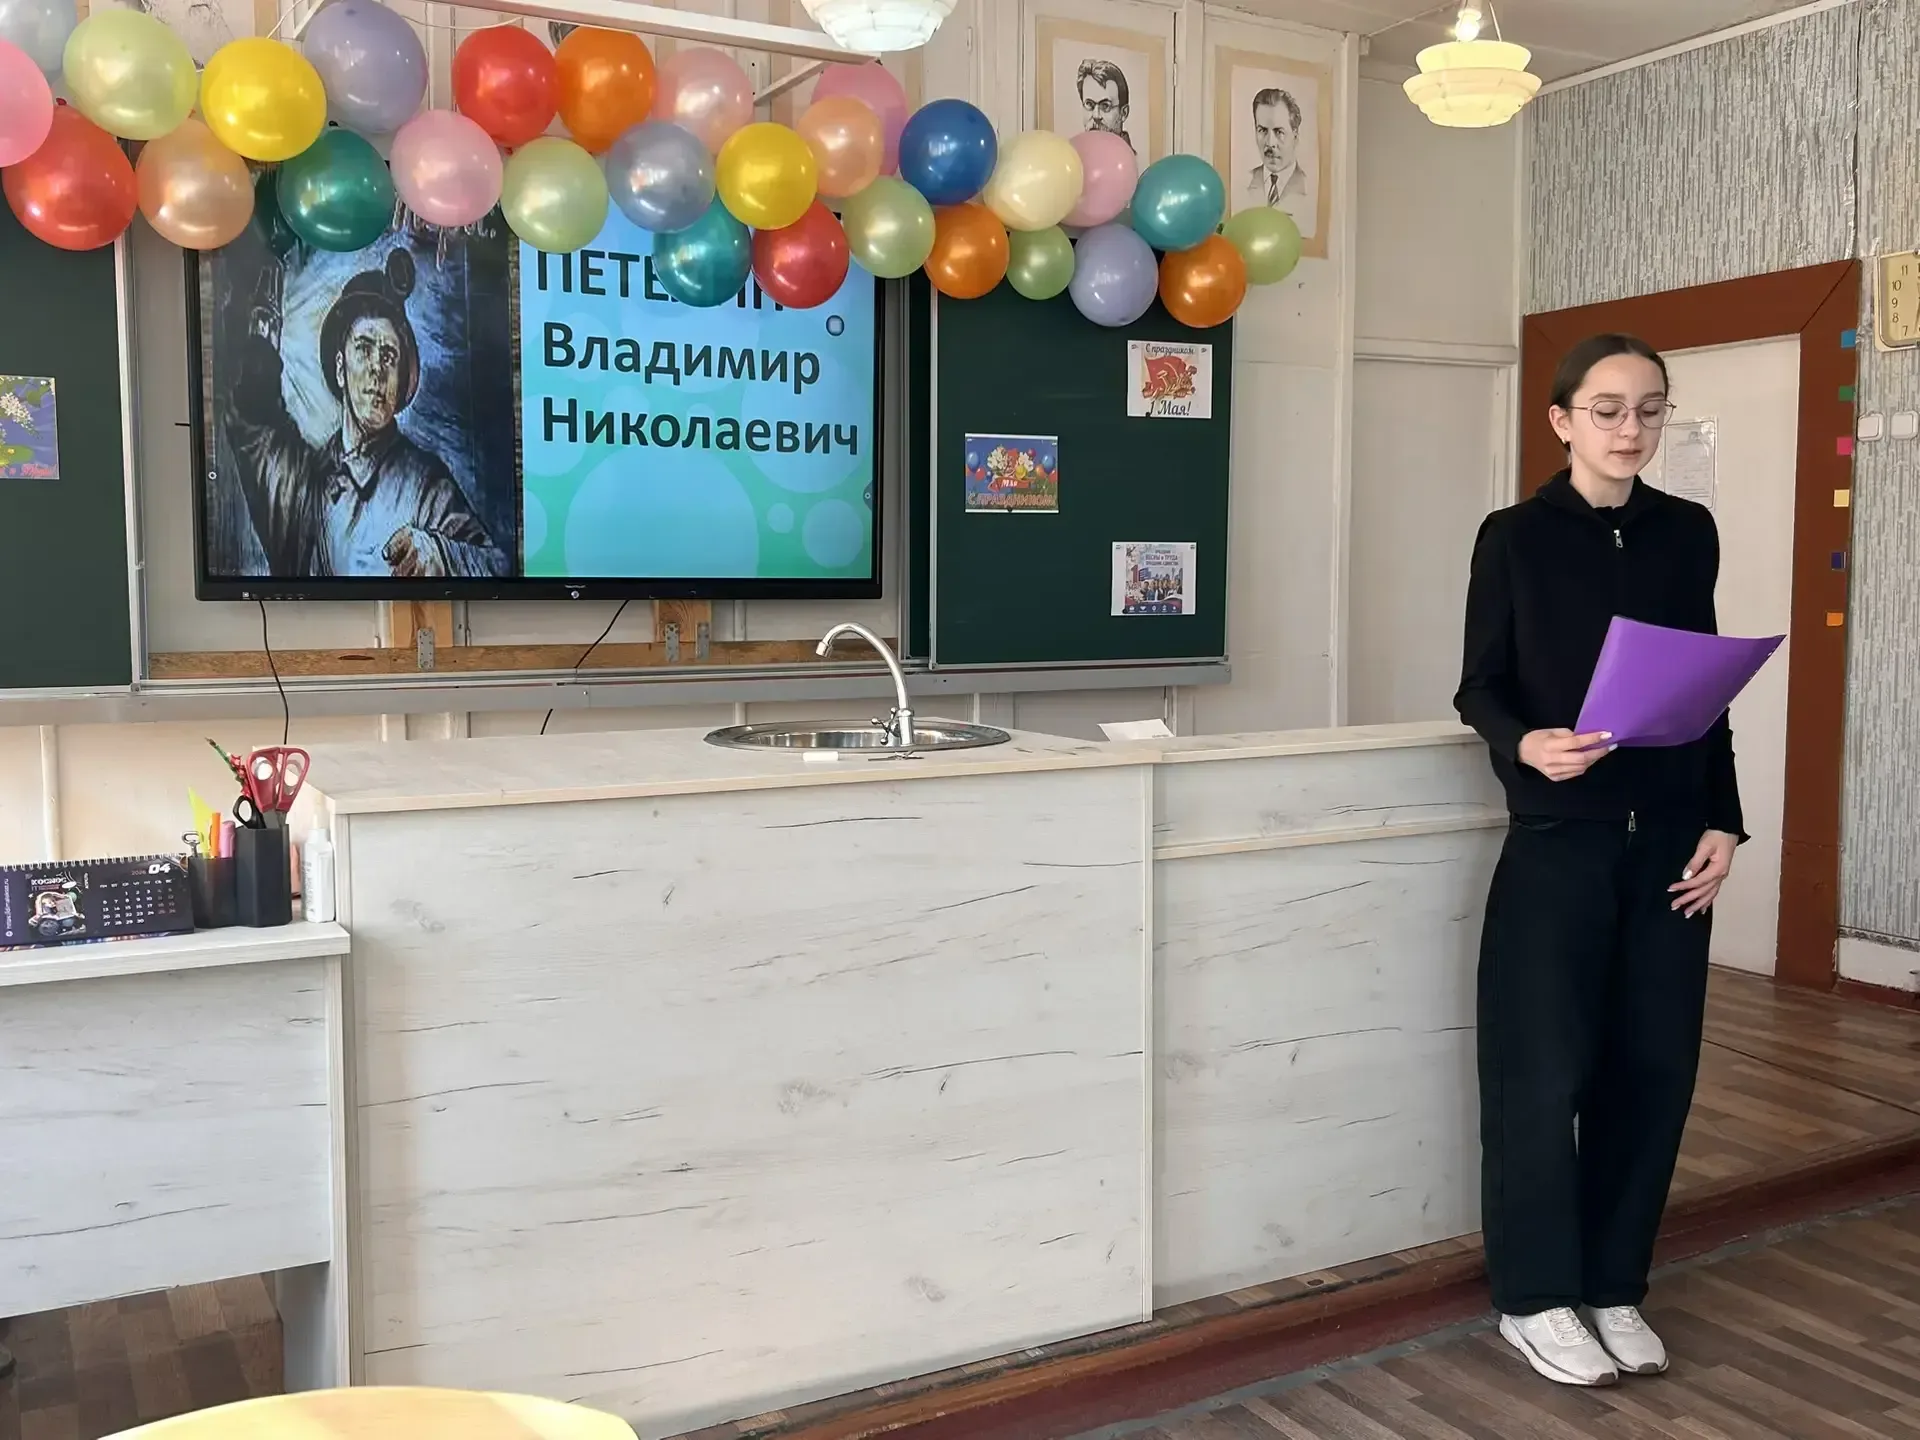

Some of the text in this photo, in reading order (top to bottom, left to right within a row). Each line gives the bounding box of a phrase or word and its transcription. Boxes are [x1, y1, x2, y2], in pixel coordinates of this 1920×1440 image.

[1901, 265, 1908, 276] 11
[537, 249, 784, 311] ПЕТЕ
[1892, 280, 1901, 291] 10
[1892, 297, 1898, 308] 9
[1892, 312, 1899, 323] 8
[1902, 325, 1908, 336] 7
[1146, 343, 1151, 353] С
[543, 321, 821, 394] Владимир
[1158, 400, 1192, 416] Мая!
[542, 396, 858, 455] Николаевич
[148, 863, 170, 874] 04
